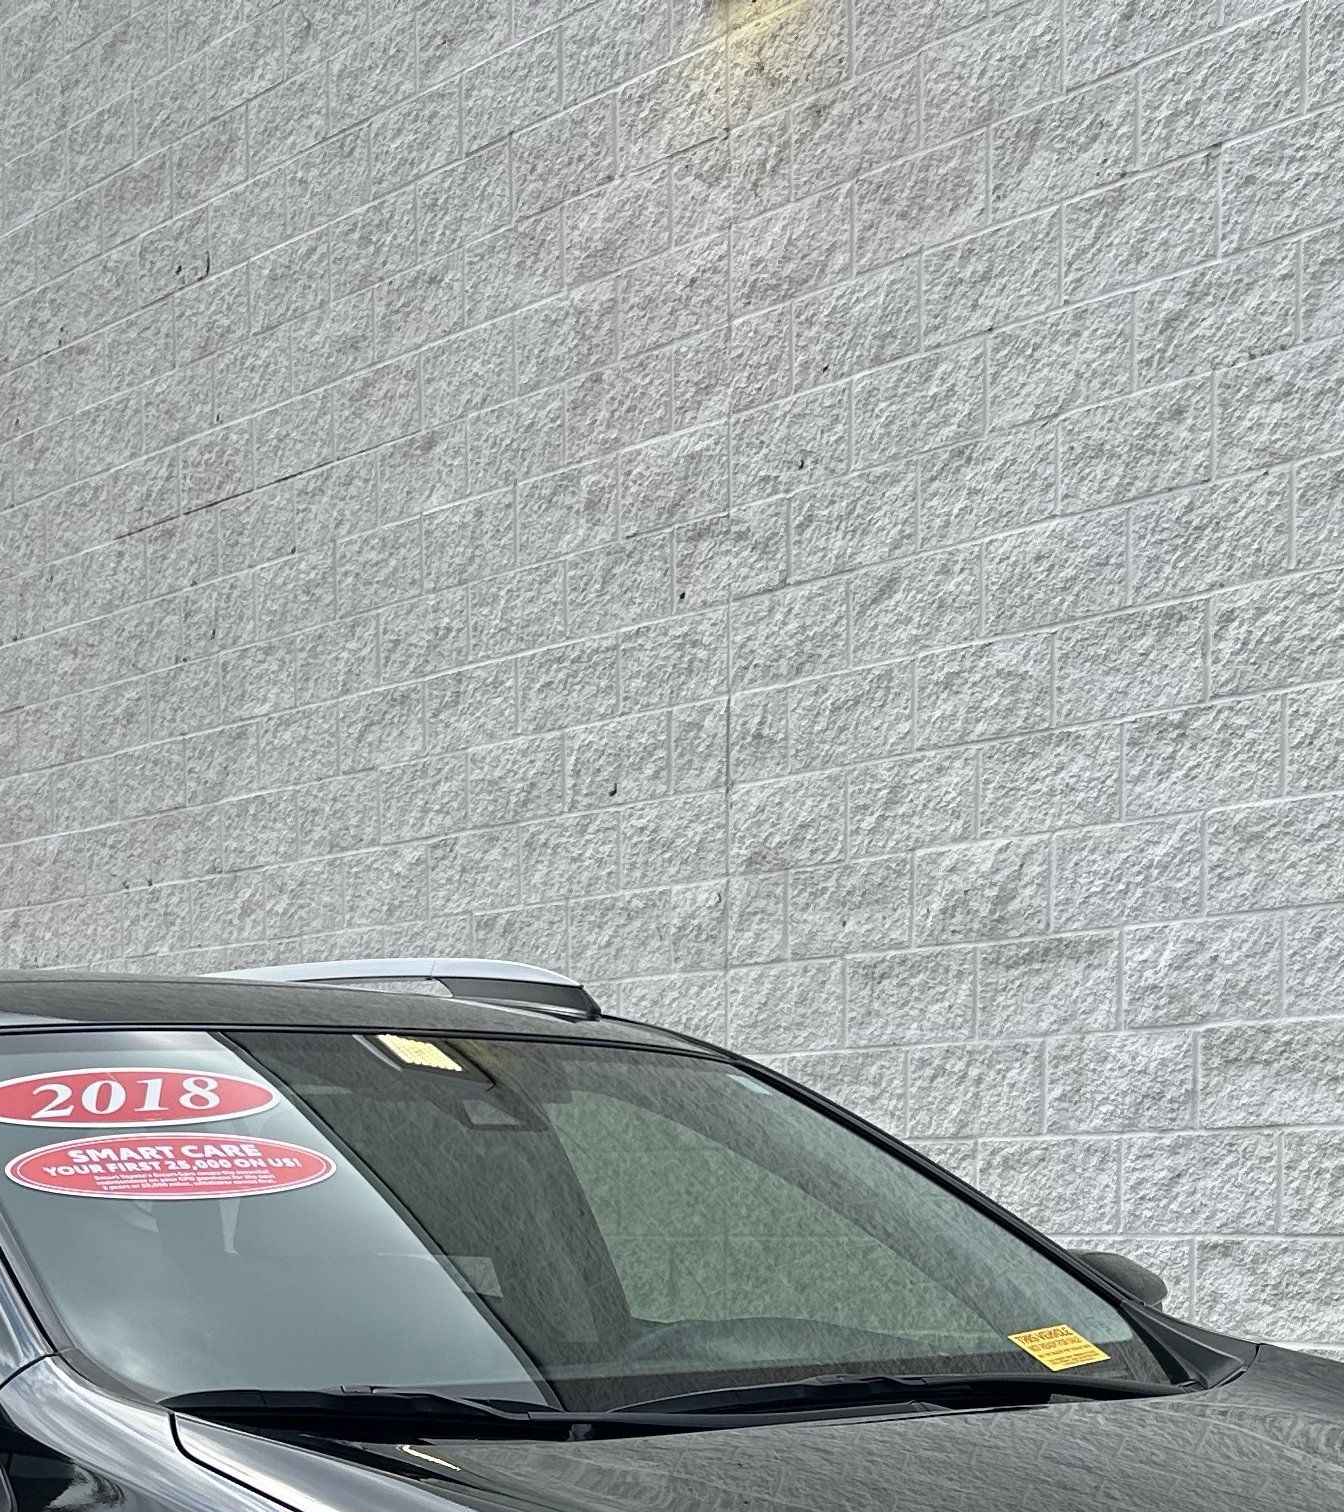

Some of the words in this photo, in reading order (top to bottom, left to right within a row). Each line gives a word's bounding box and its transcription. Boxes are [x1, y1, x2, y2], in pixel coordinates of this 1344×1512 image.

[31, 1076, 221, 1119] 2018
[67, 1145, 175, 1163] SMART
[180, 1143, 263, 1159] CARE
[42, 1163, 106, 1177] YOUR
[105, 1161, 162, 1173] FIRST
[233, 1158, 267, 1169] ON
[267, 1157, 303, 1168] US!
